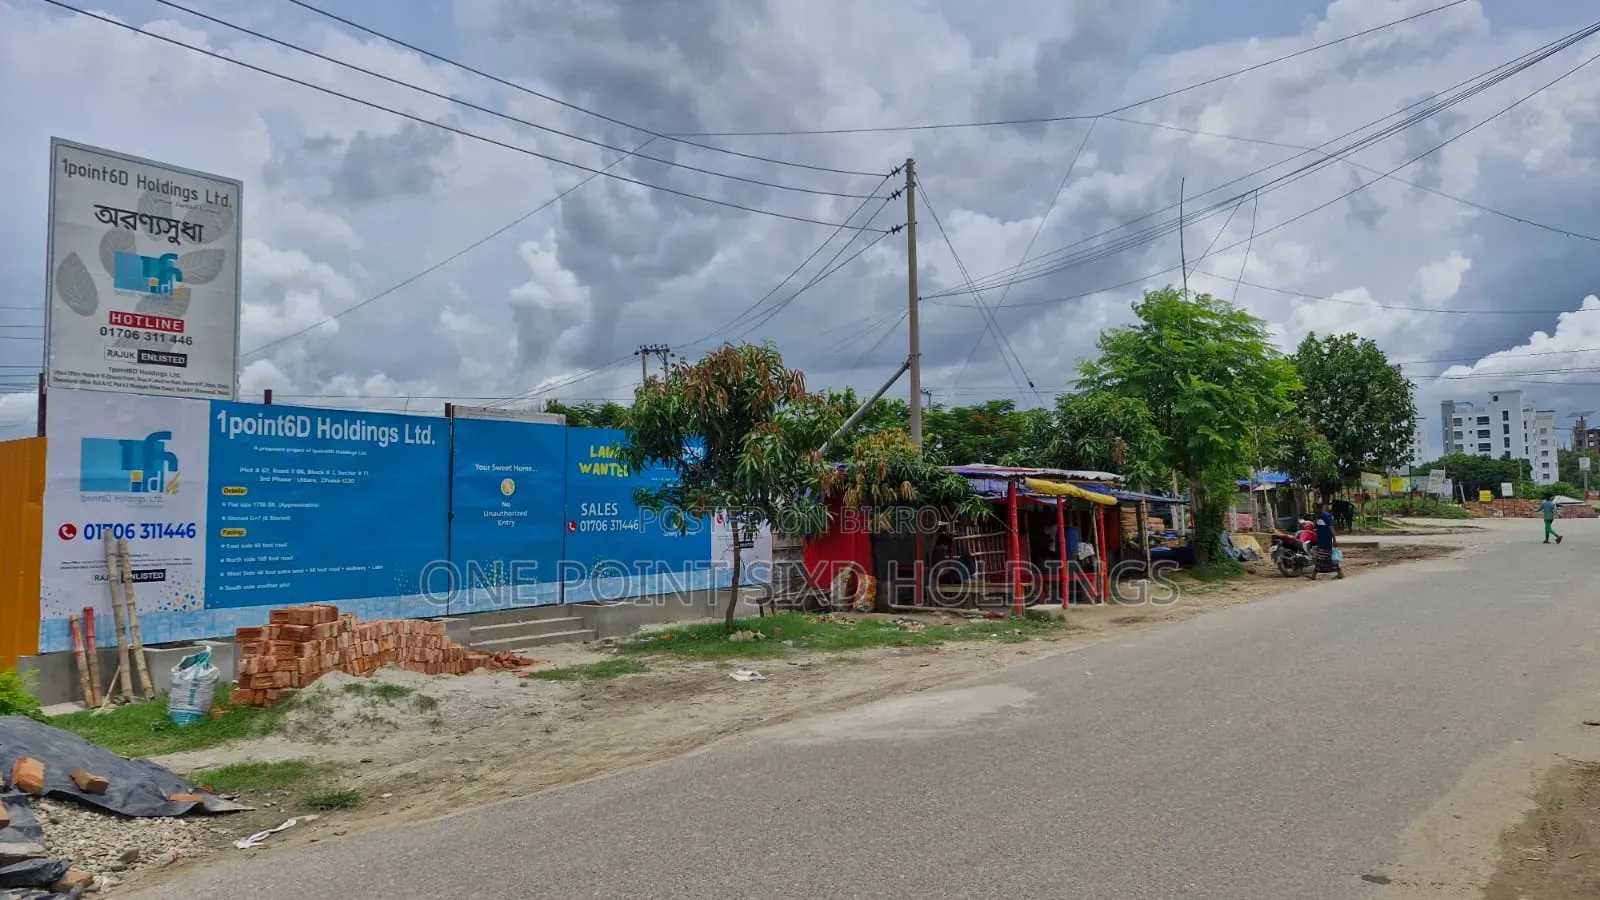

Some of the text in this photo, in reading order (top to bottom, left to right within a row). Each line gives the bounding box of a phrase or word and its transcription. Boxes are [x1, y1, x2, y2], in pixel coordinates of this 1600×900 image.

[61, 157, 128, 187] 1point6D
[136, 174, 199, 202] Holdings
[205, 188, 233, 208] Ltd.
[111, 313, 183, 331] HOTLINE
[99, 326, 193, 346] 01706 311 446
[107, 349, 186, 365] RAJUK ENLISTED
[217, 409, 436, 448] 1point6D Holdings Ltd.
[475, 463, 490, 471] Your
[491, 463, 512, 472] Sweet
[483, 510, 528, 518] Unauthorized
[580, 502, 618, 517] SALES
[139, 522, 197, 540] 311446
[497, 519, 516, 527] Entry
[580, 518, 639, 532] 01706 311446
